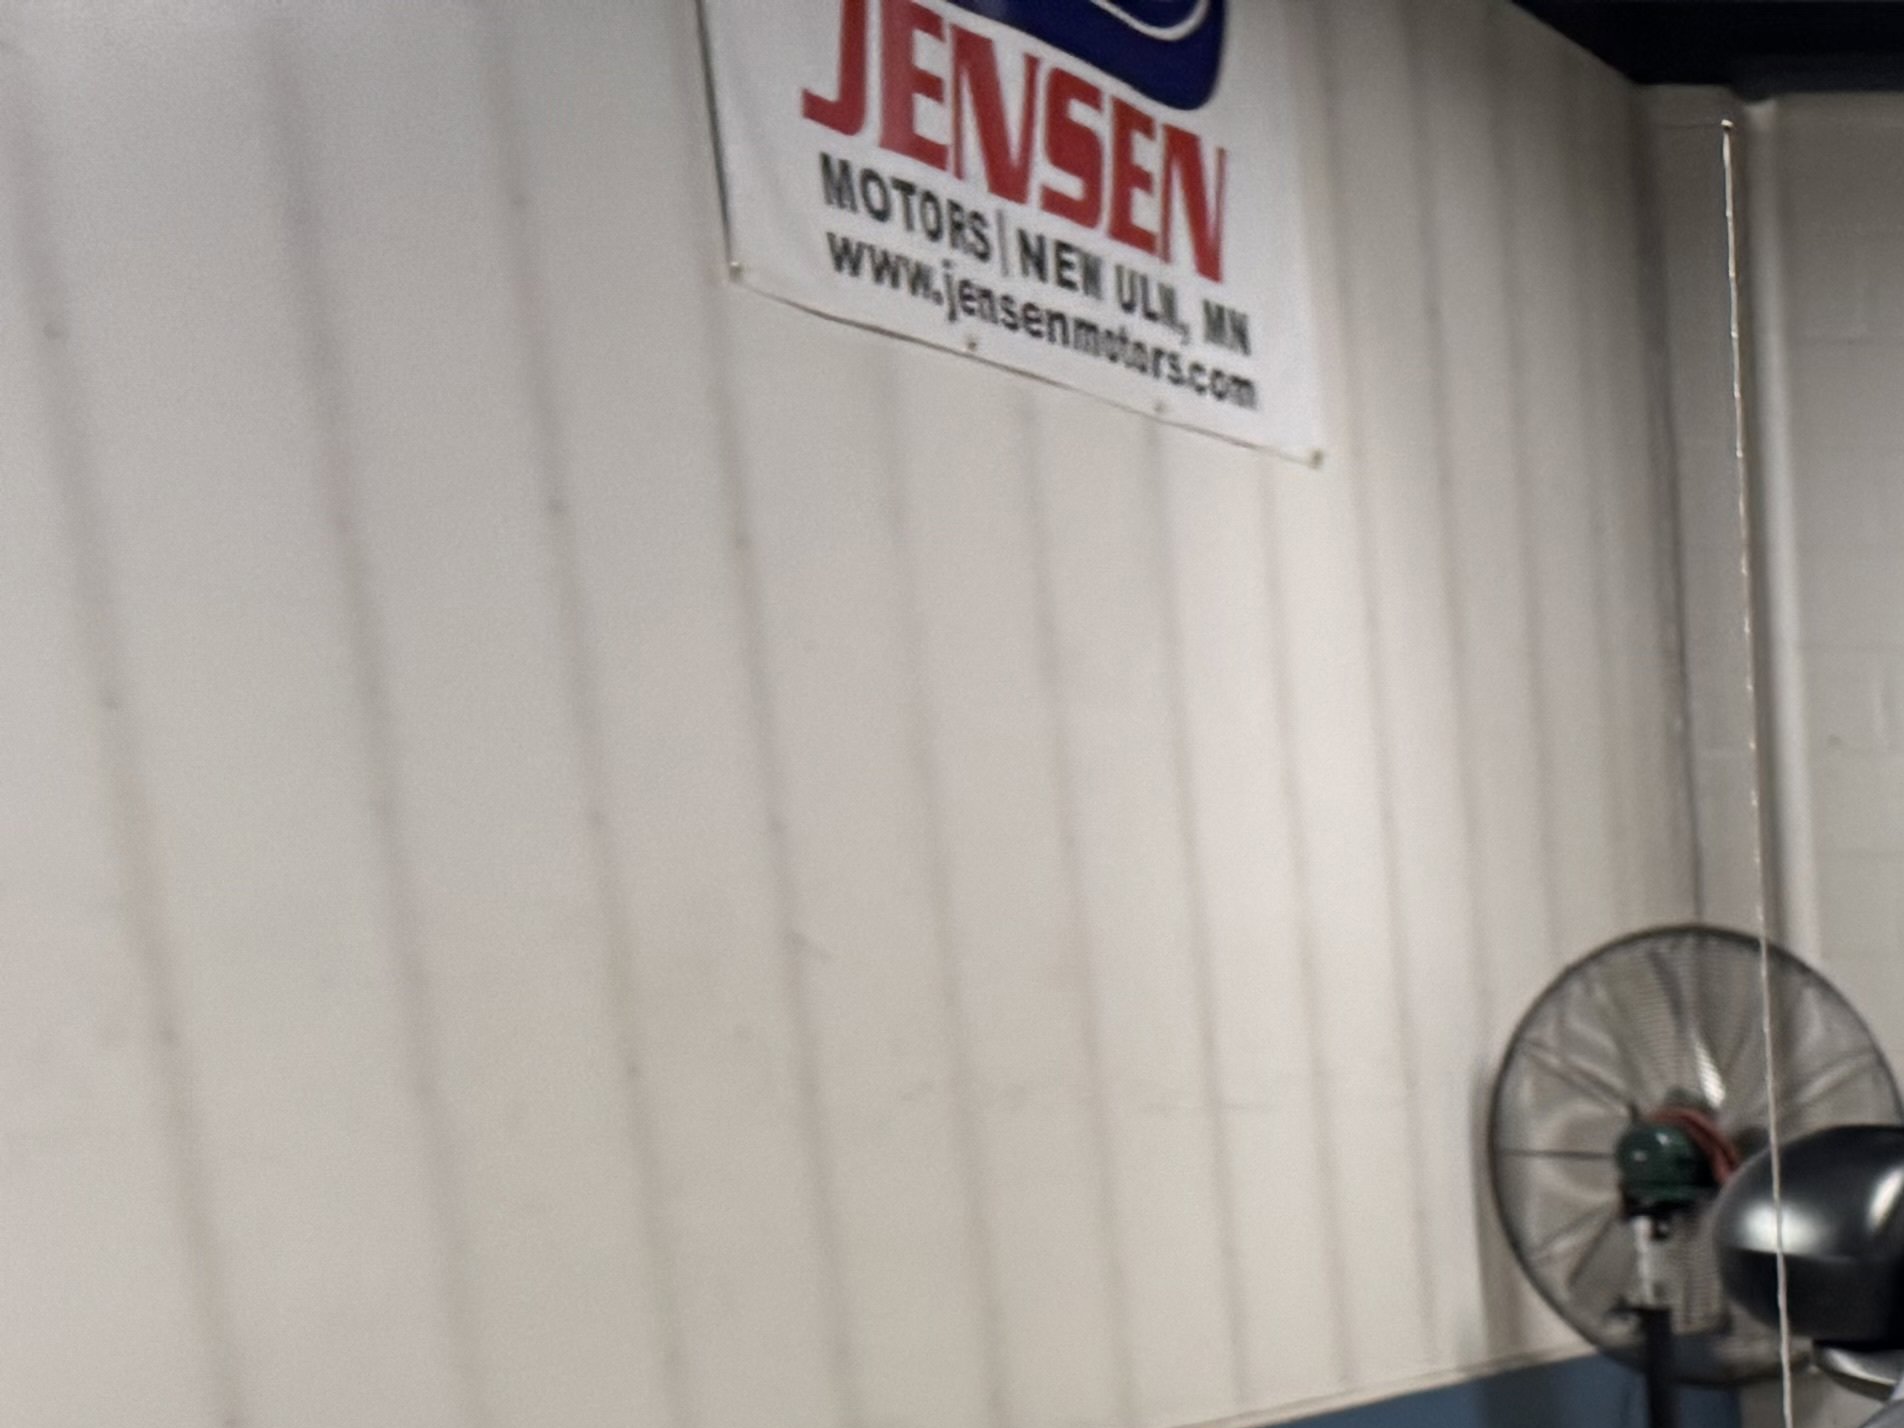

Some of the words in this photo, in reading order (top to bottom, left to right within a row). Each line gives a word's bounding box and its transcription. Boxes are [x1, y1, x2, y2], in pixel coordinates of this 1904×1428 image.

[800, 0, 1229, 284] JENSEN
[818, 150, 992, 265] MOTORS
[1017, 224, 1104, 301] NEW
[1202, 297, 1253, 358] MN
[824, 229, 1258, 411] www.jensenmotors.com
